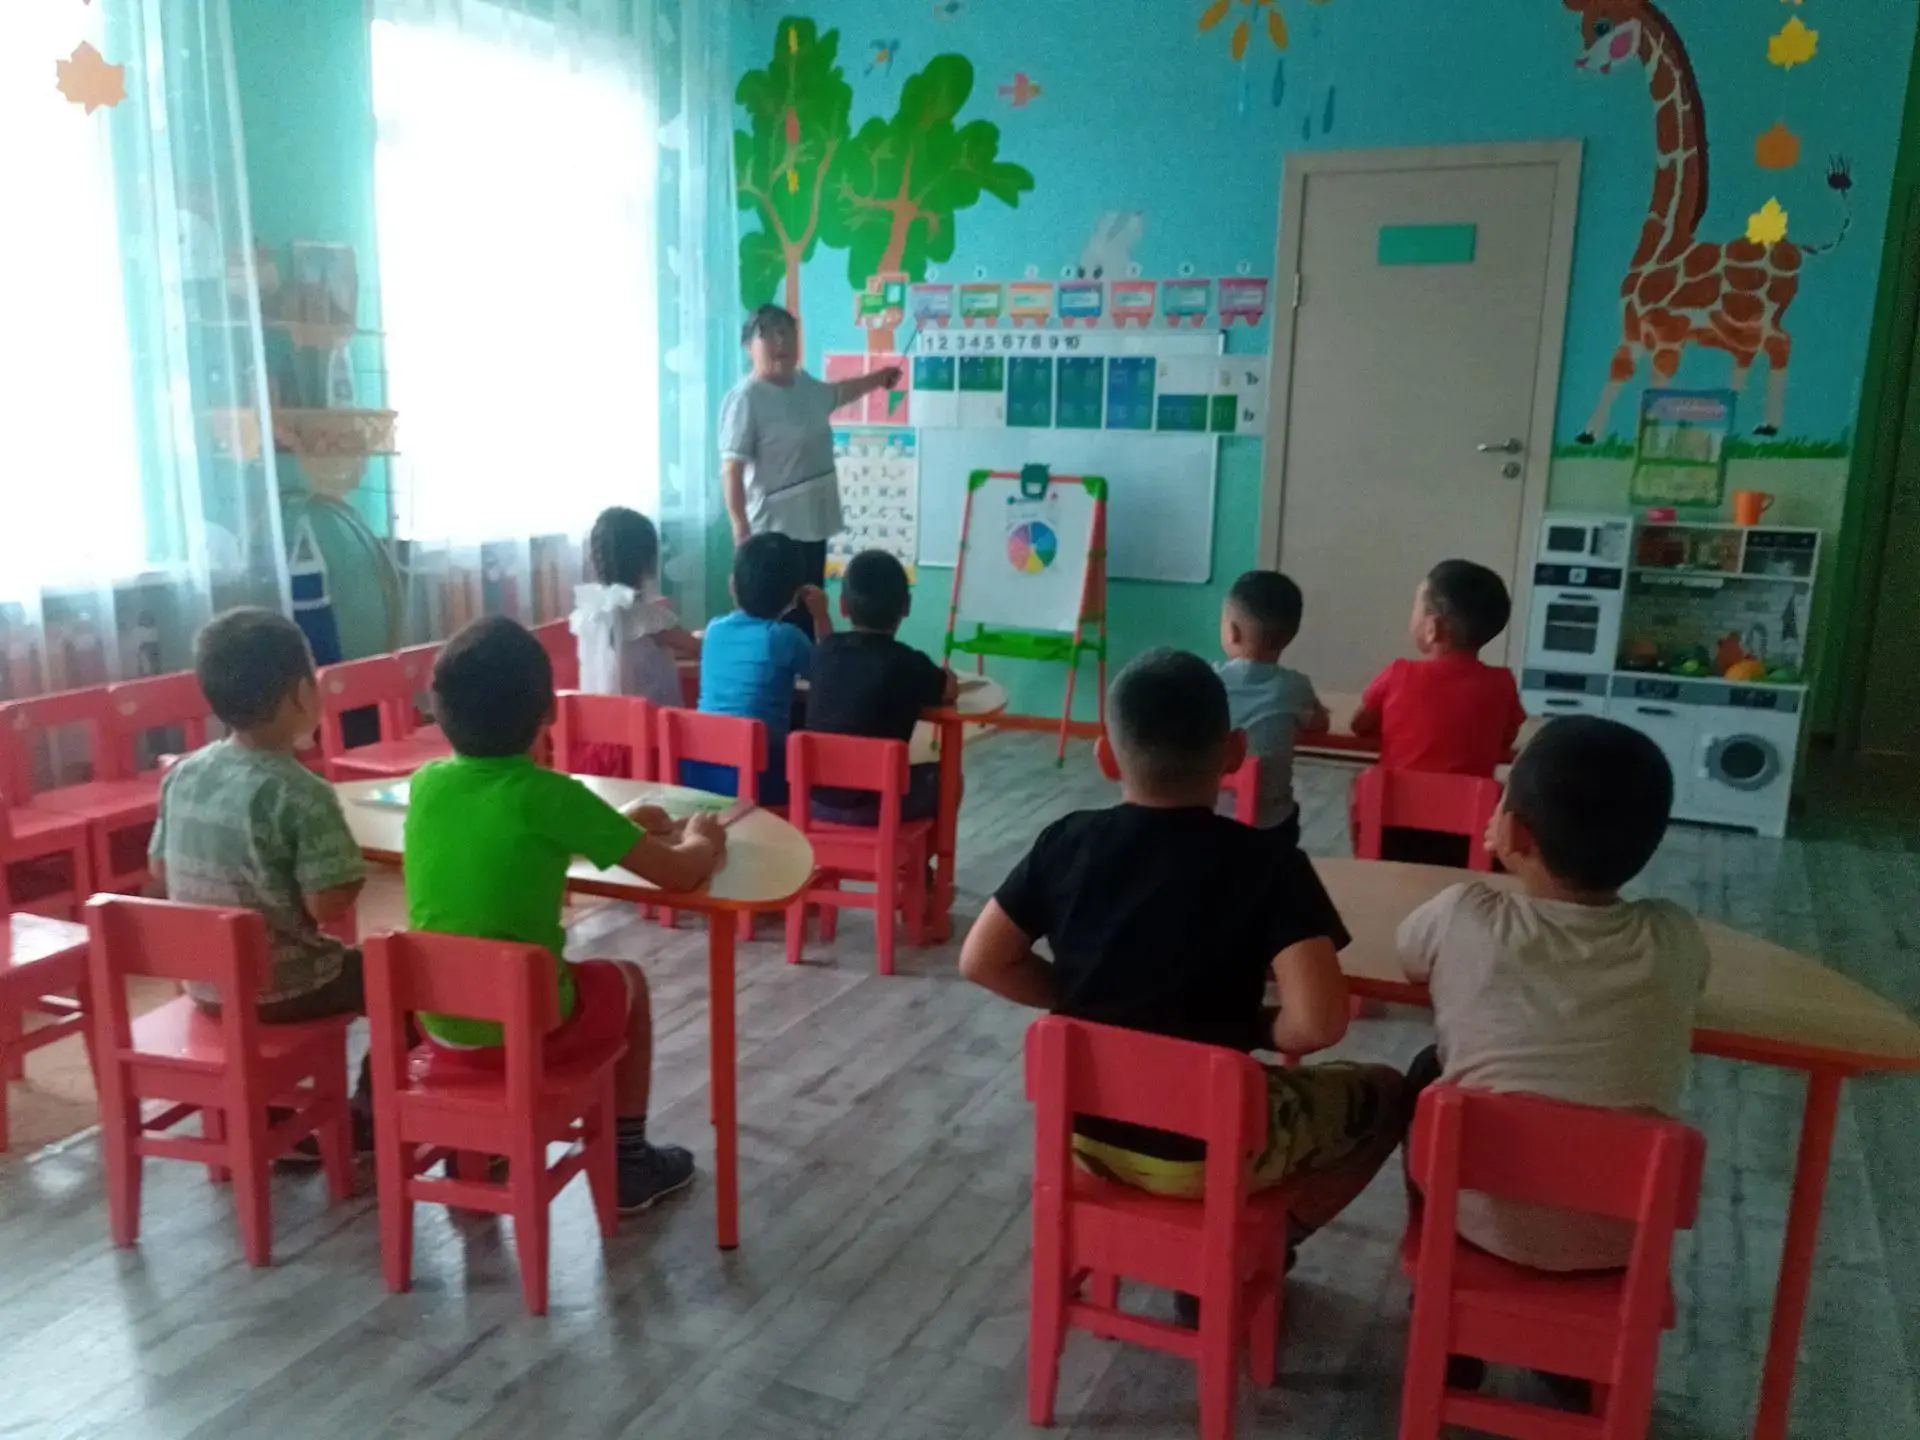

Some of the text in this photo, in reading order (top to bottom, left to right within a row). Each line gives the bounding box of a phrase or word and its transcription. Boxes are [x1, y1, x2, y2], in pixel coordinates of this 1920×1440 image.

[926, 335, 1080, 350] 1 2 3 4 5 6 7 8 9 10
